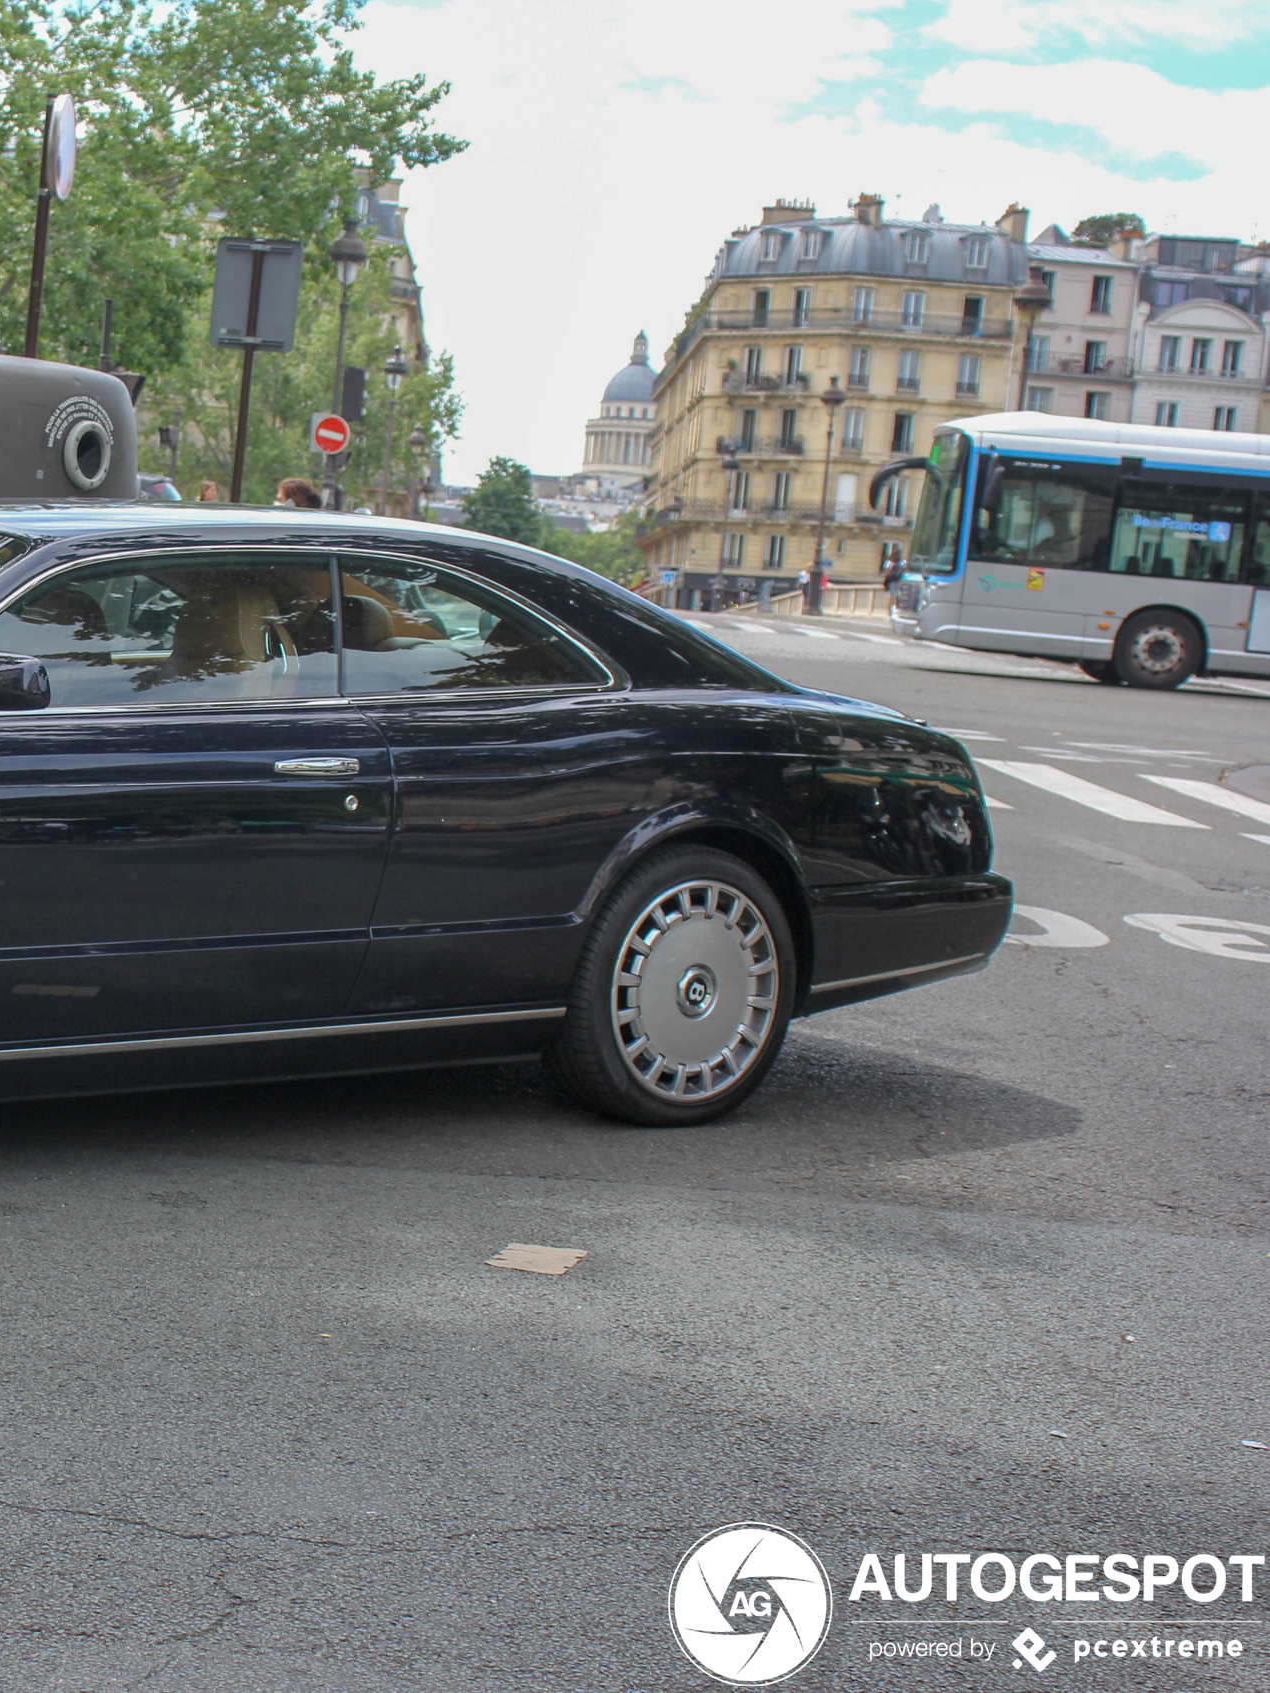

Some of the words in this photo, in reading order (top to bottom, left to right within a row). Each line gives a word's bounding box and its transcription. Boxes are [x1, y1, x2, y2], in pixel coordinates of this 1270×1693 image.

[44, 415, 56, 434] POUR
[53, 408, 61, 417] LA
[47, 427, 58, 448] MERCI
[55, 417, 62, 427] DE
[60, 411, 67, 419] NE
[66, 405, 76, 414] PAS
[56, 420, 68, 440] ENTRE
[88, 411, 95, 419] ET
